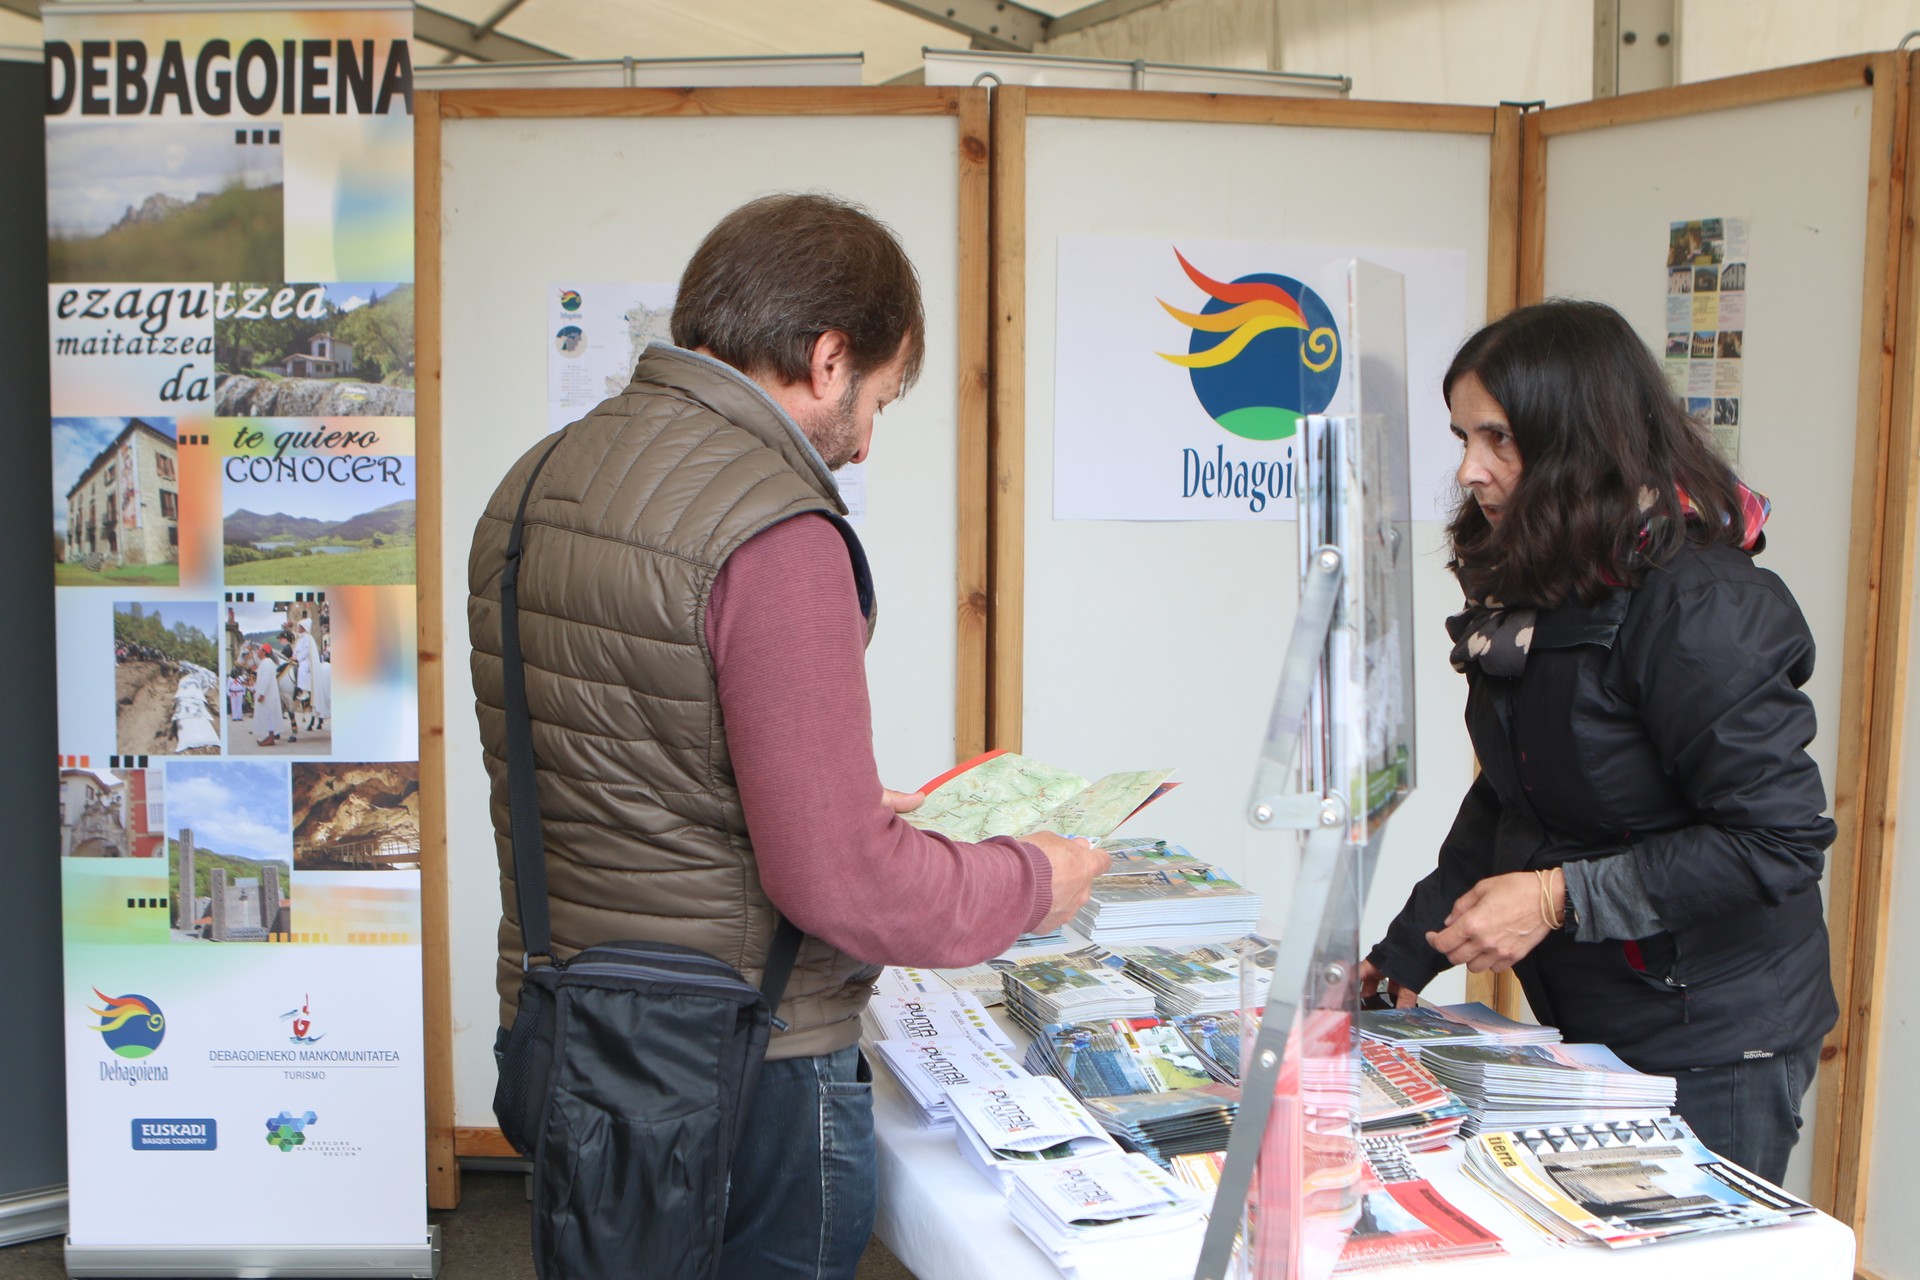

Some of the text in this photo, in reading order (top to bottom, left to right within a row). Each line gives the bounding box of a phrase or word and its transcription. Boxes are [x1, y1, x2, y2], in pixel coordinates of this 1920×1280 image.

[45, 38, 413, 116] DEBAGOIENA
[57, 284, 327, 334] ezagutzea
[56, 330, 215, 356] maitatzea
[159, 363, 210, 401] da
[233, 425, 379, 461] te quiero
[225, 455, 406, 485] CONOCER
[209, 1050, 400, 1062] DEBAGOIENEKO MANKOMUNITATEA
[99, 1060, 169, 1086] Debagoiena
[284, 1070, 326, 1080] TURISMO
[141, 1124, 206, 1136] EUSKADI
[141, 1137, 207, 1145] BASQUE COUNTRY
[1488, 1136, 1517, 1167] tierra
